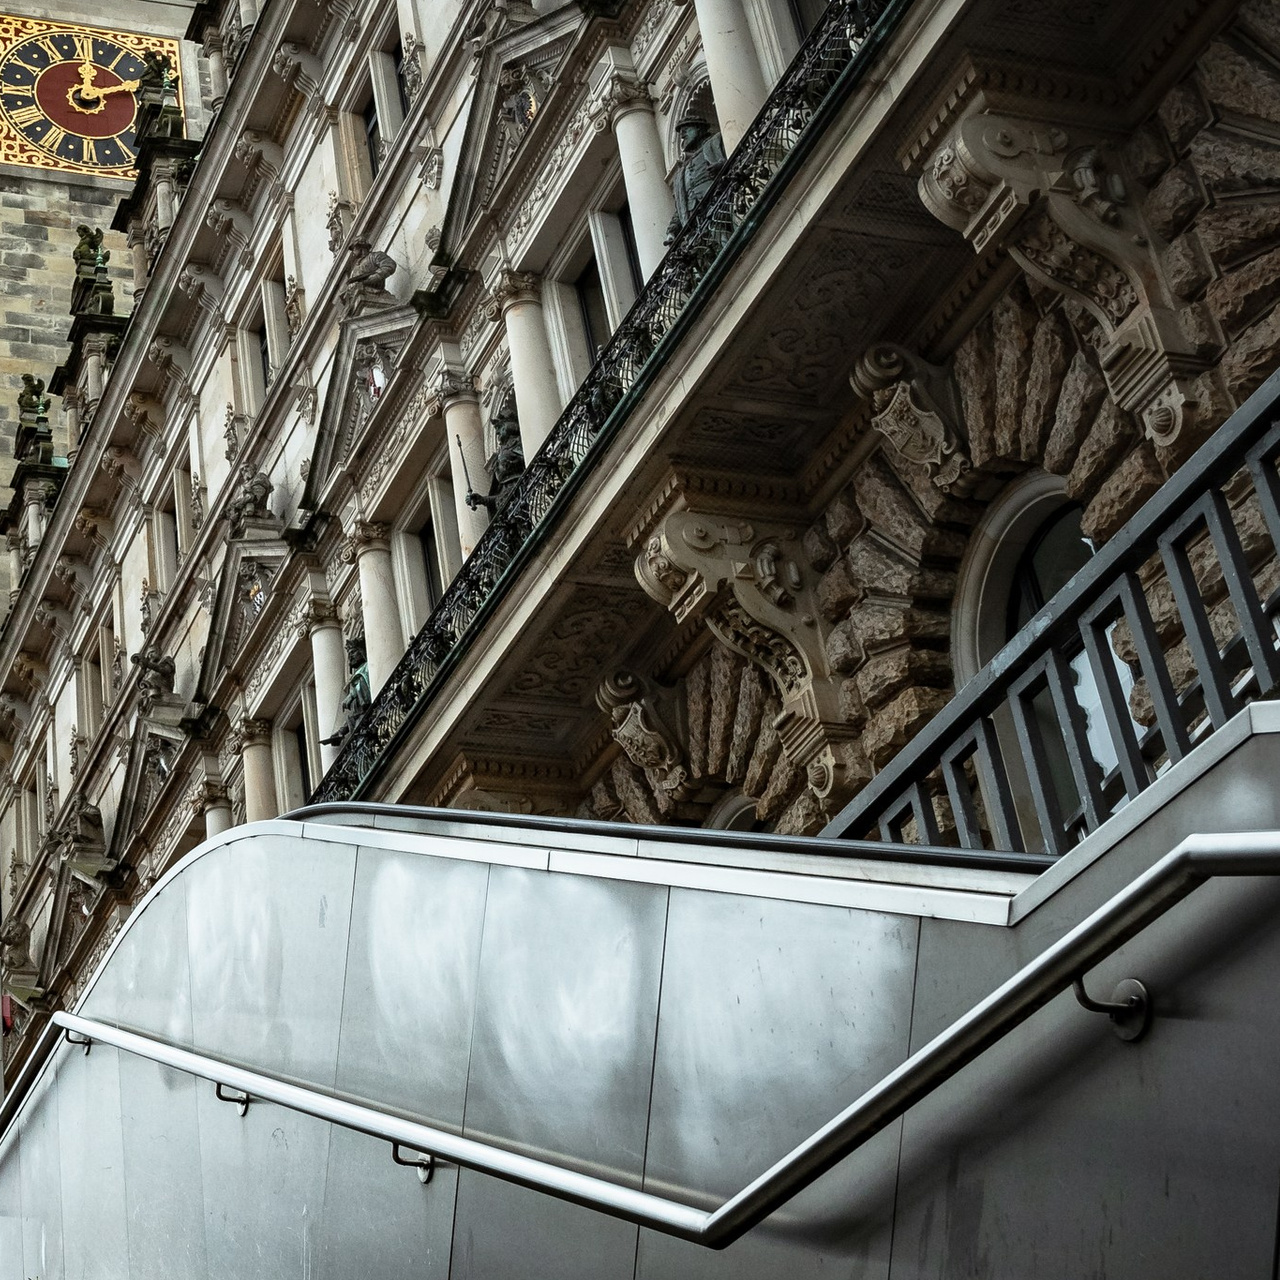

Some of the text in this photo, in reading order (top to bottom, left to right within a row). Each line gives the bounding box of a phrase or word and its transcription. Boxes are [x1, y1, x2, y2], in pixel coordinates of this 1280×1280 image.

[72, 35, 94, 61] XII
[10, 54, 41, 77] X
[9, 104, 45, 129] VIII
